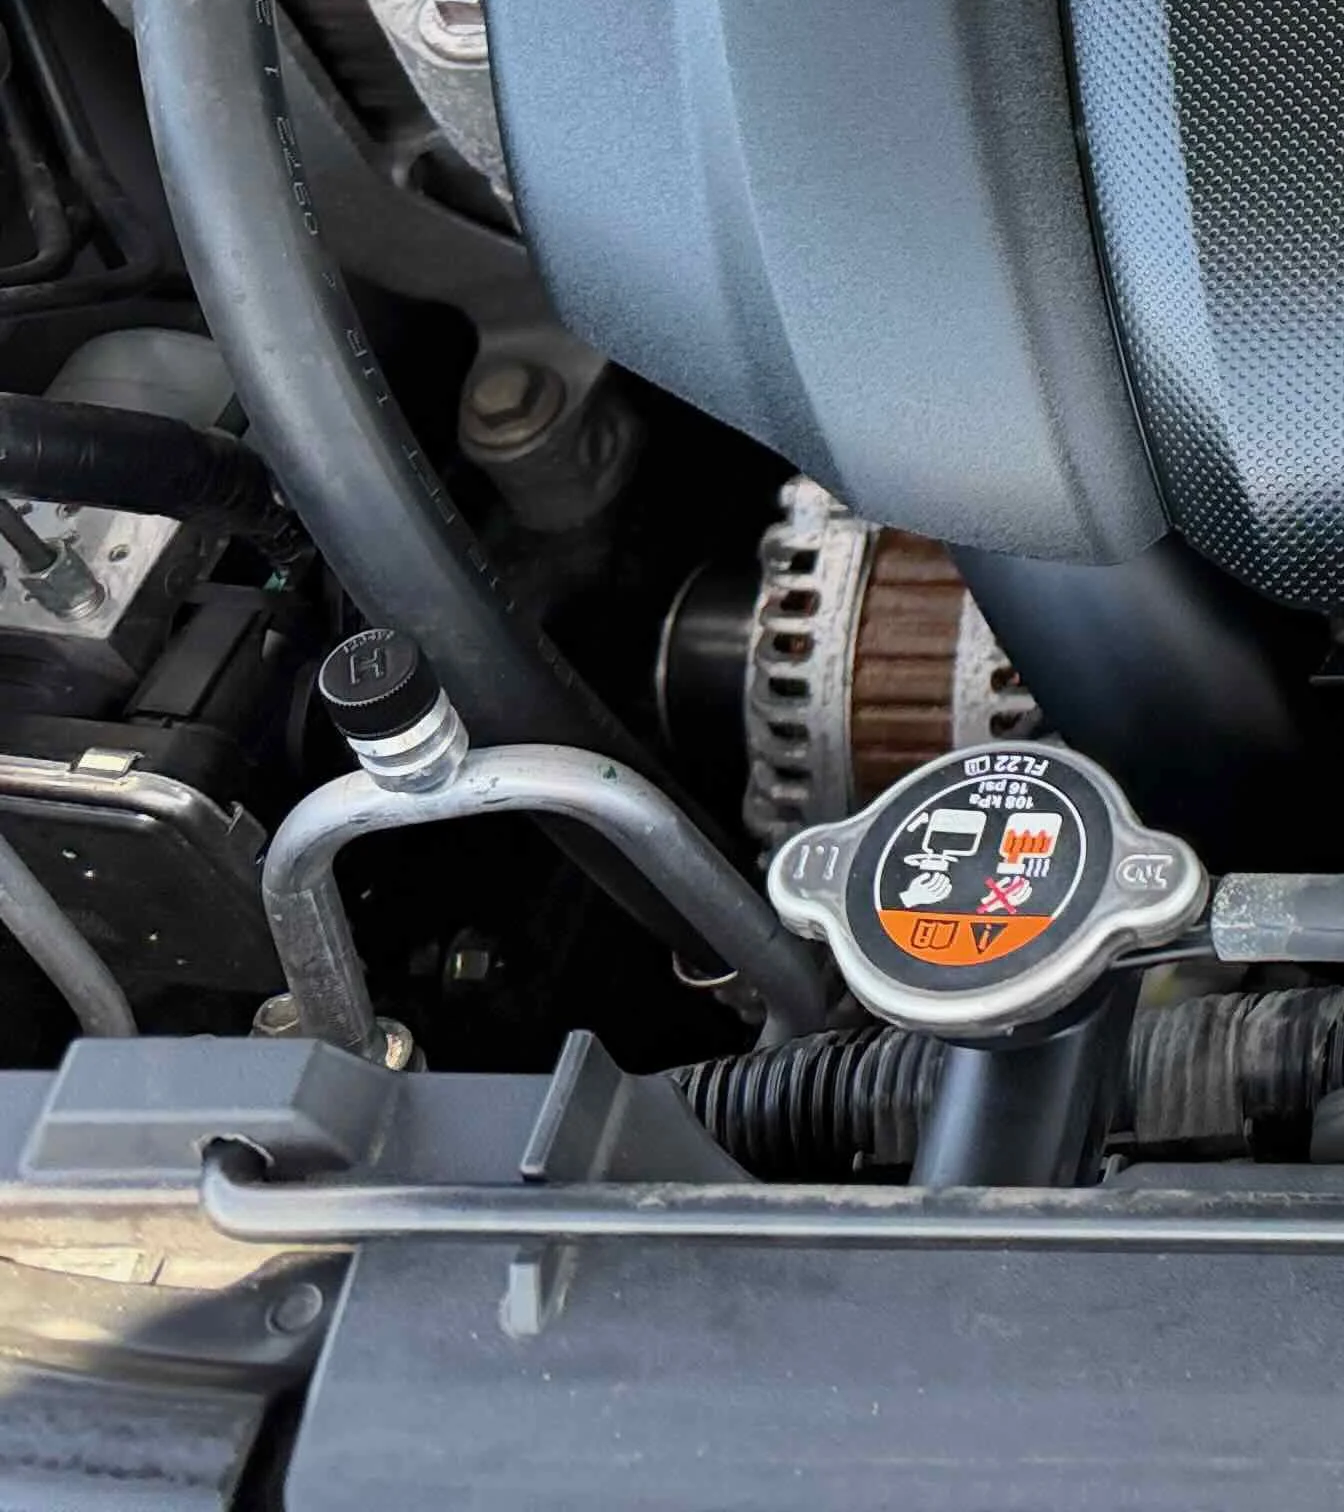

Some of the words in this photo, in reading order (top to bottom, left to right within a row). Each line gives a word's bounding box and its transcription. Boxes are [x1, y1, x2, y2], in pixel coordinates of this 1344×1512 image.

[993, 755, 1050, 777] FL22
[977, 779, 1007, 795] psi
[1008, 781, 1029, 795] 16
[968, 792, 1003, 809] kPa
[1004, 794, 1035, 810] 108
